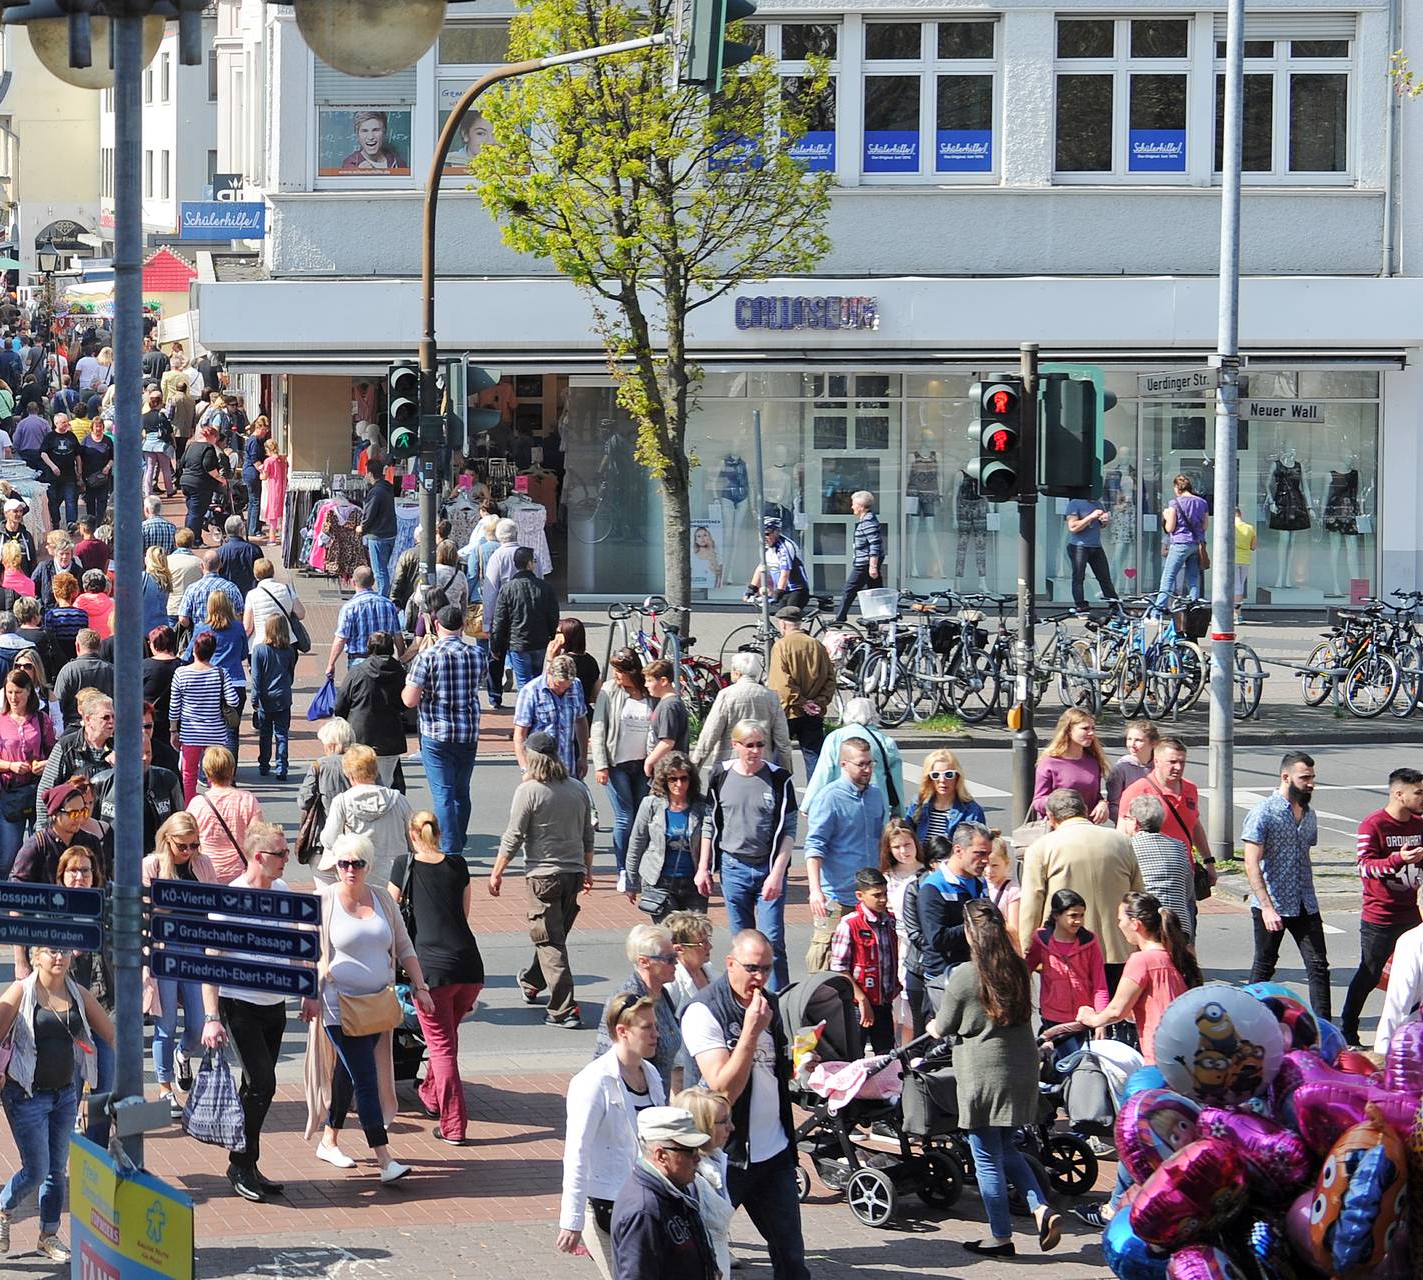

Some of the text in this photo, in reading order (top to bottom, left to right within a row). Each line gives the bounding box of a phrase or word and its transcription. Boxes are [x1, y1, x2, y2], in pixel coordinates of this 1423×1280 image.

[1147, 373, 1210, 392] Uerdinger Str.
[1250, 403, 1317, 418] Neuer Wall
[161, 887, 216, 906] KÖ-Viertel
[8, 926, 29, 937] Wall
[31, 927, 49, 938] und
[50, 928, 84, 941] Graben
[179, 926, 244, 944] Grafschafter
[246, 932, 294, 951] Passage
[180, 960, 292, 987] Friedrich-Ebert-Platz
